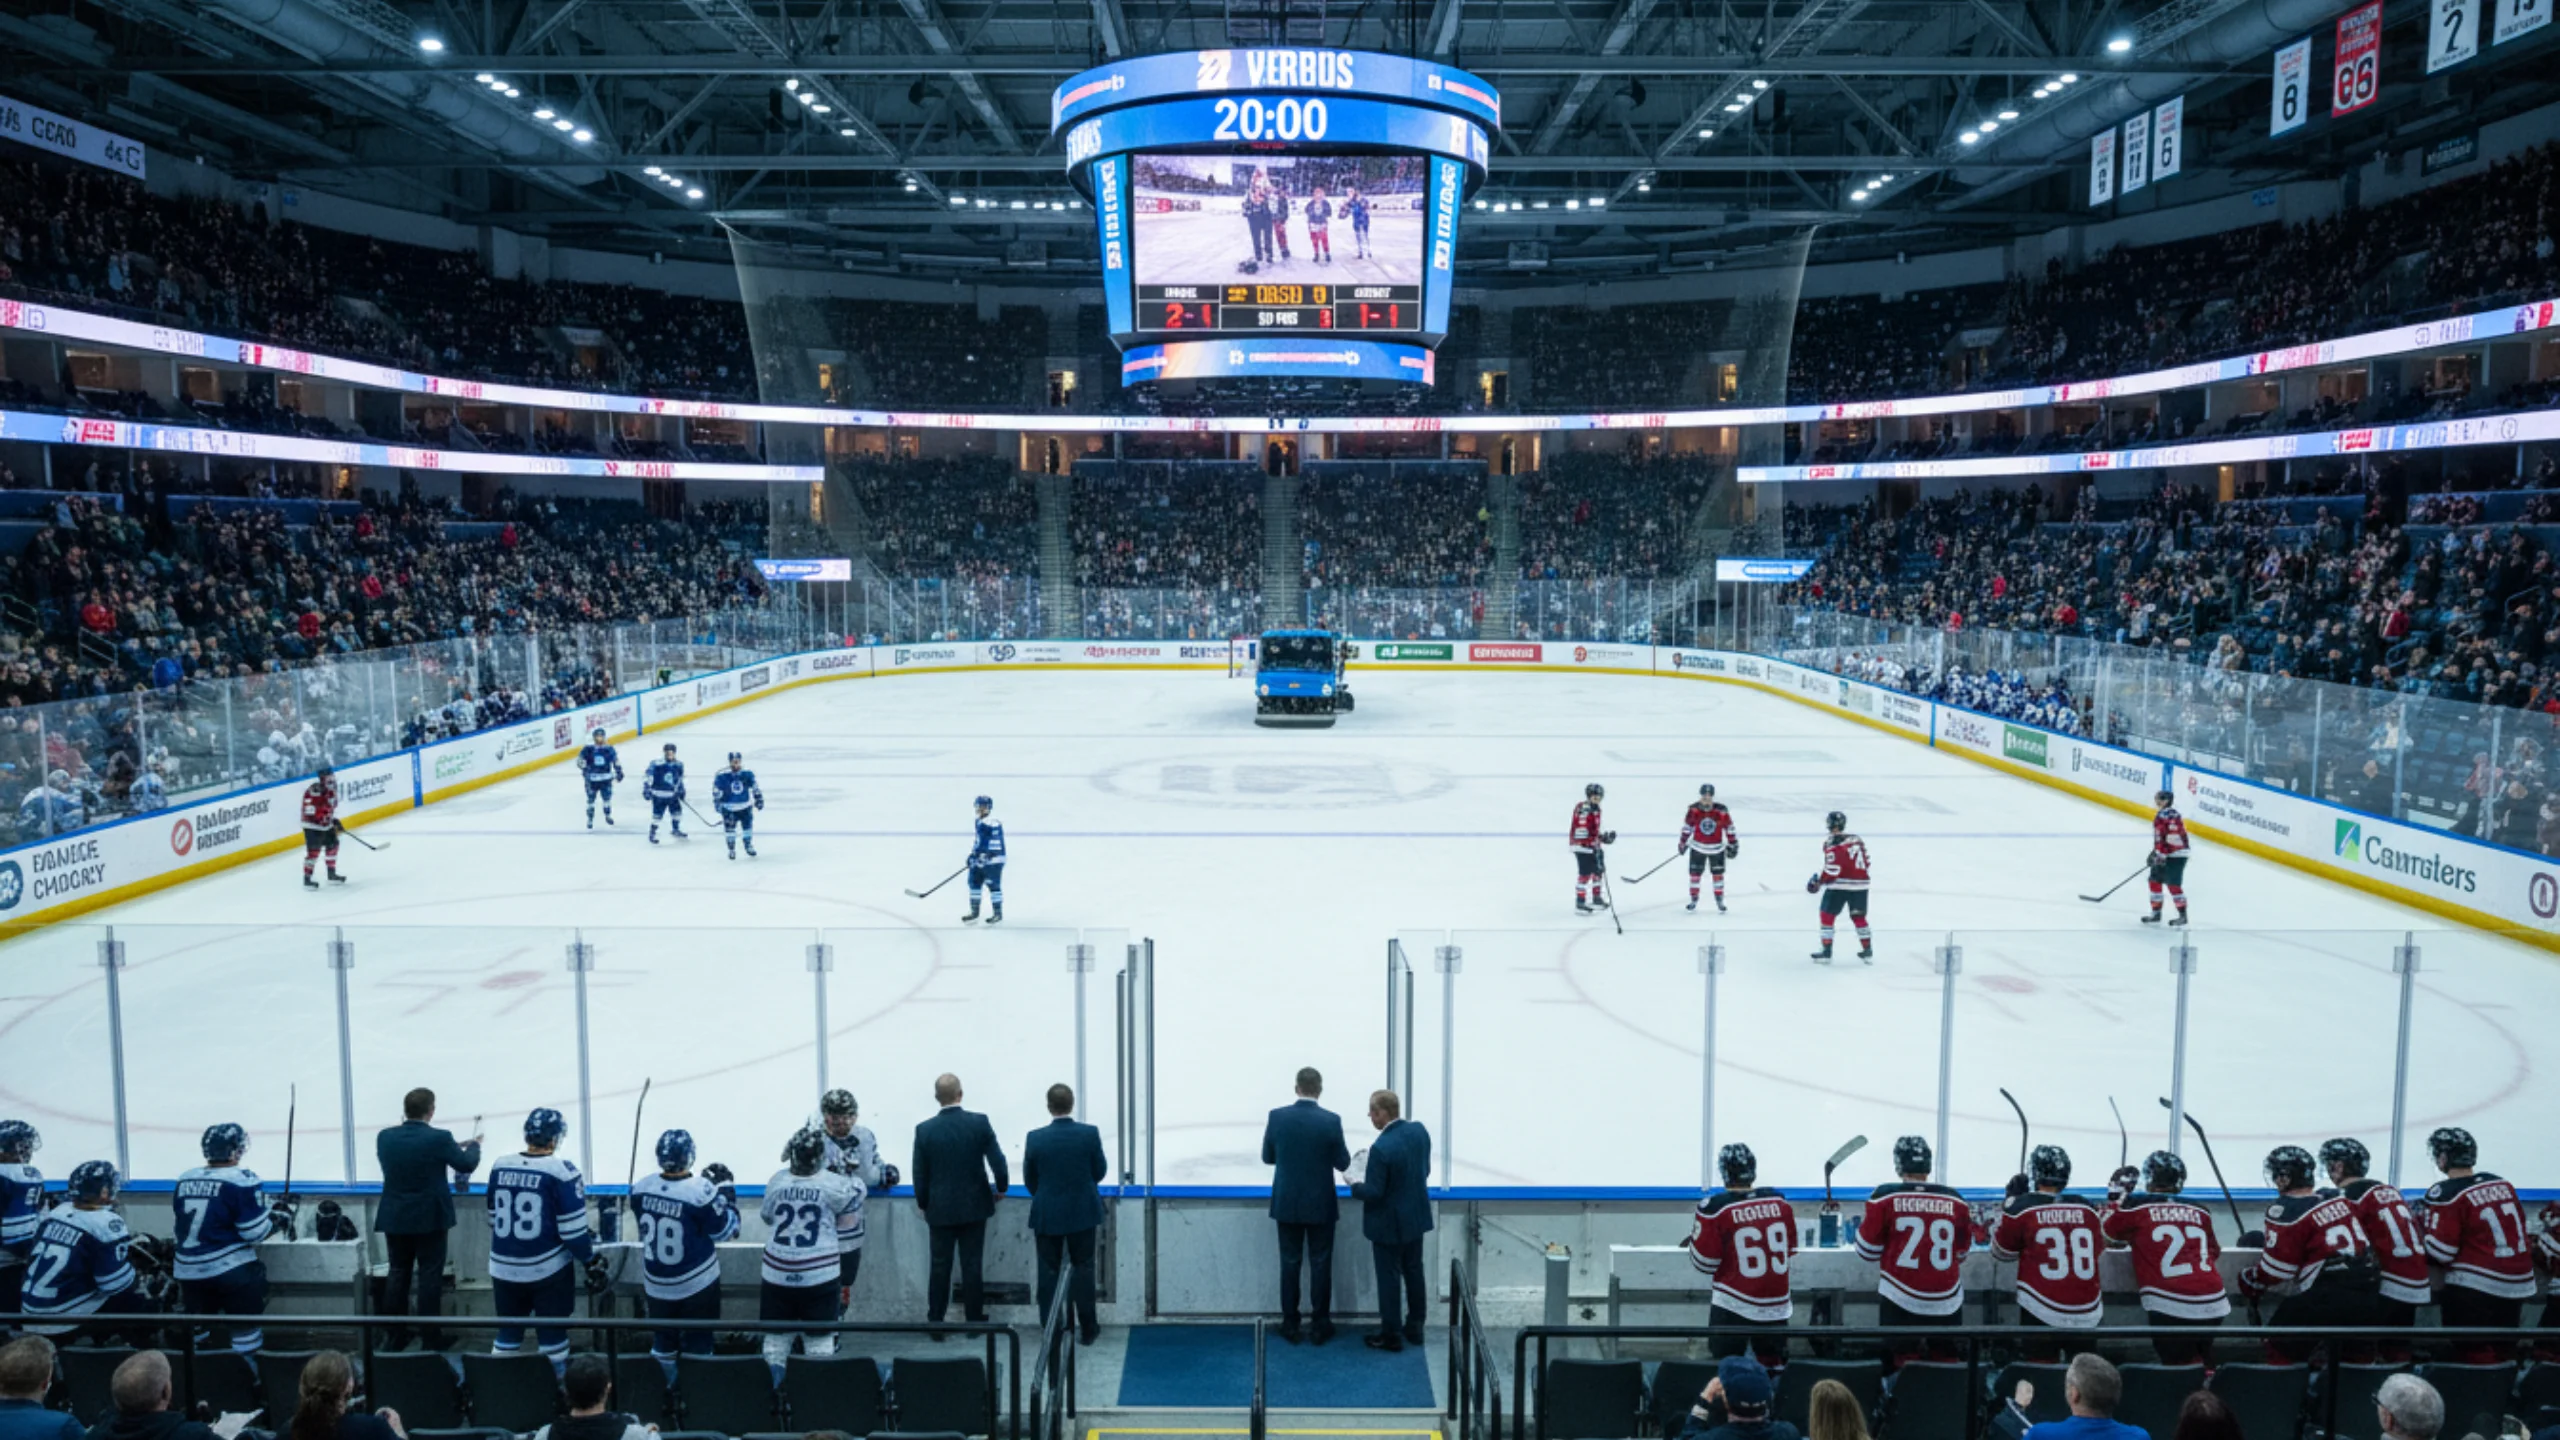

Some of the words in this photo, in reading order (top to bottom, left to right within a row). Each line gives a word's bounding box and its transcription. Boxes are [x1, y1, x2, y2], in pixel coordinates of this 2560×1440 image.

[2443, 9, 2464, 54] 2
[1213, 98, 1328, 141] 20:00
[182, 1199, 209, 1249] 7
[494, 1188, 543, 1241] 88
[639, 1212, 685, 1266] 28
[772, 1202, 822, 1248] 23
[2479, 1196, 2527, 1258] 17
[1733, 1221, 1788, 1279] 69
[2034, 1227, 2095, 1280] 38
